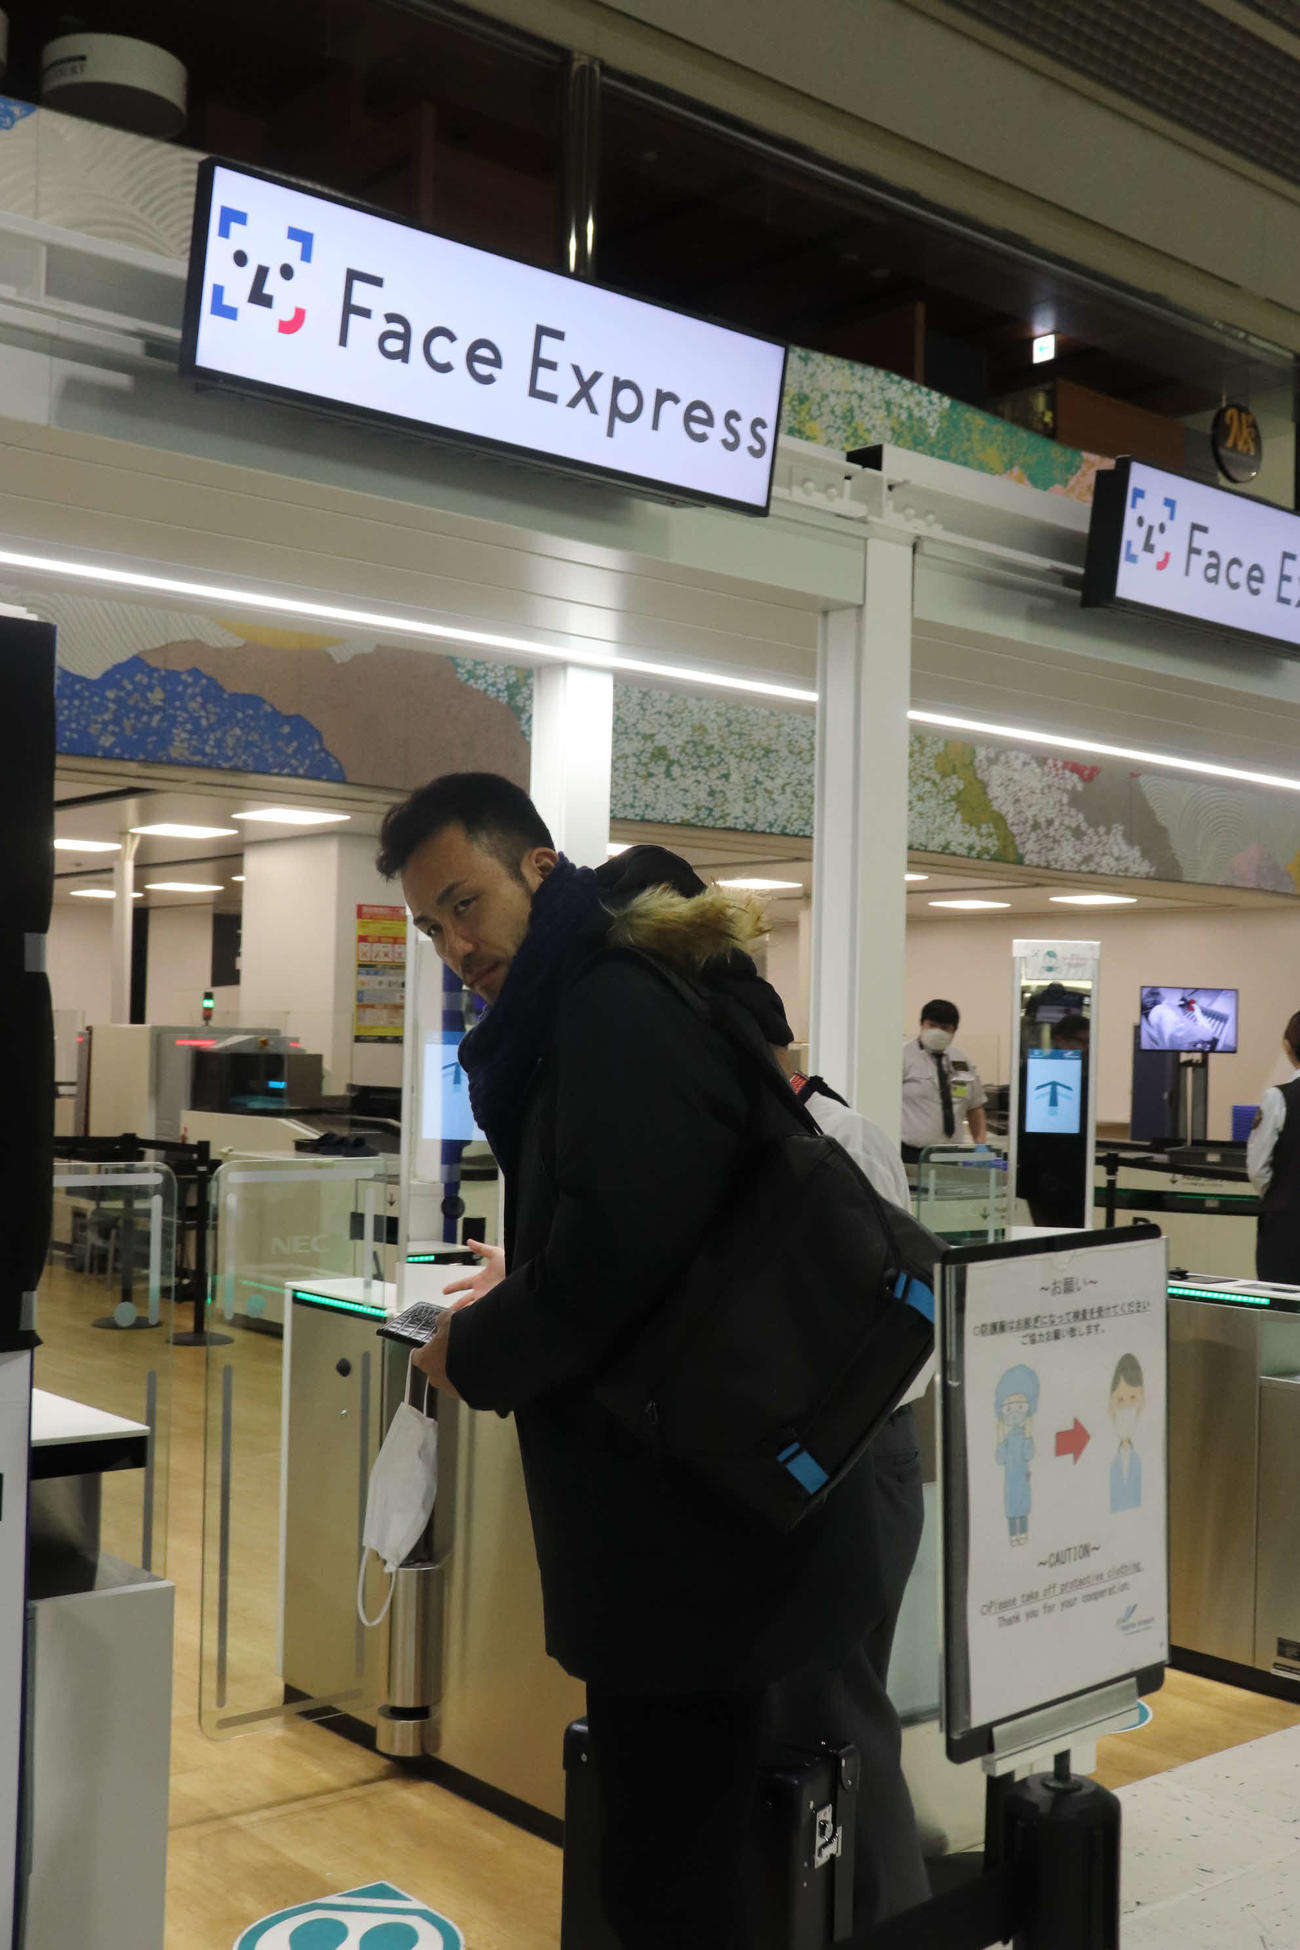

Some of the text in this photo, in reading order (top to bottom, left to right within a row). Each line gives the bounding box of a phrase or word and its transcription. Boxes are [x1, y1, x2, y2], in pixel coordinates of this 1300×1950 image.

[338, 267, 768, 460] Face Express
[1184, 521, 1265, 596] Face
[271, 1234, 330, 1255] NEC
